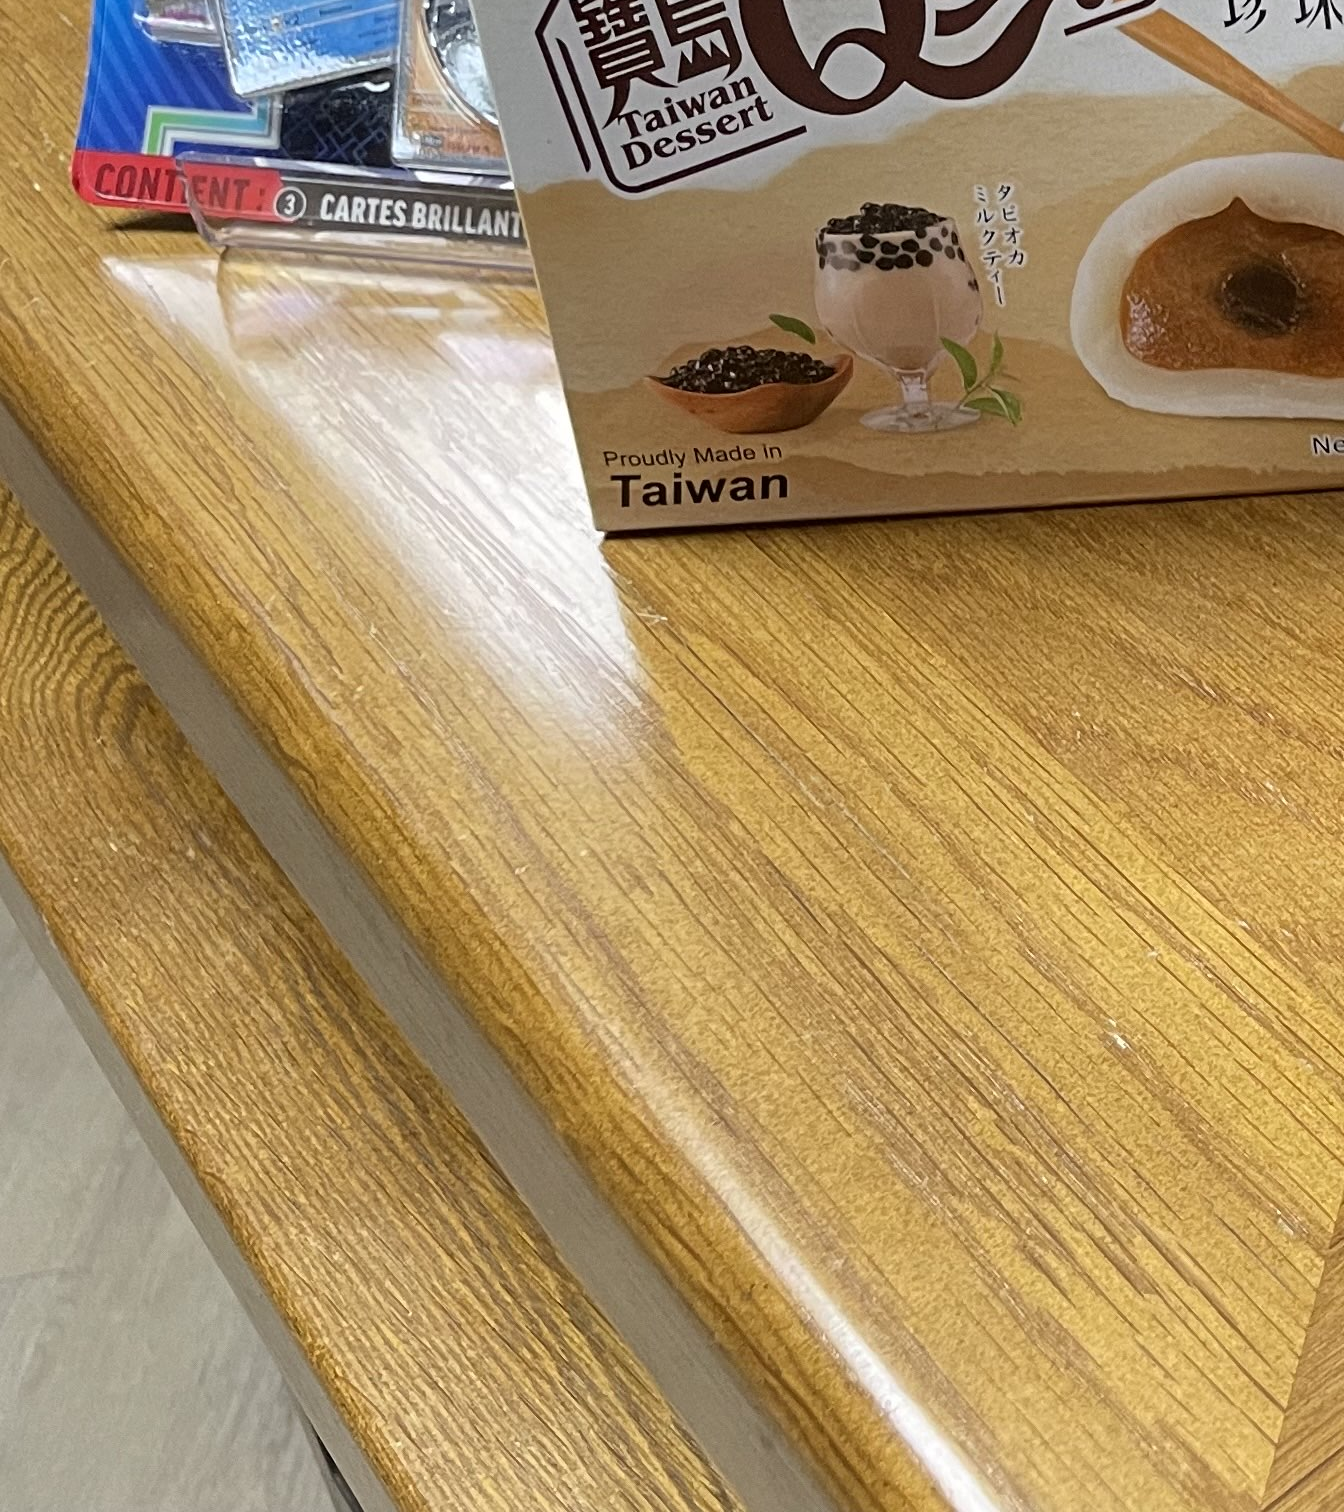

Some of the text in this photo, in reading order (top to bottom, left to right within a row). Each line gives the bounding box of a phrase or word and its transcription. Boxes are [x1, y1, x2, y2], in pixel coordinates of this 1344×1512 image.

[617, 75, 757, 141] Taiwan
[620, 96, 775, 172] Dessert
[282, 192, 298, 216] 3
[319, 192, 523, 239] CARTES BRILLANT
[998, 184, 1024, 266] タピオカ
[602, 443, 783, 469] Proudly Made in
[610, 471, 789, 508] Taiwan
